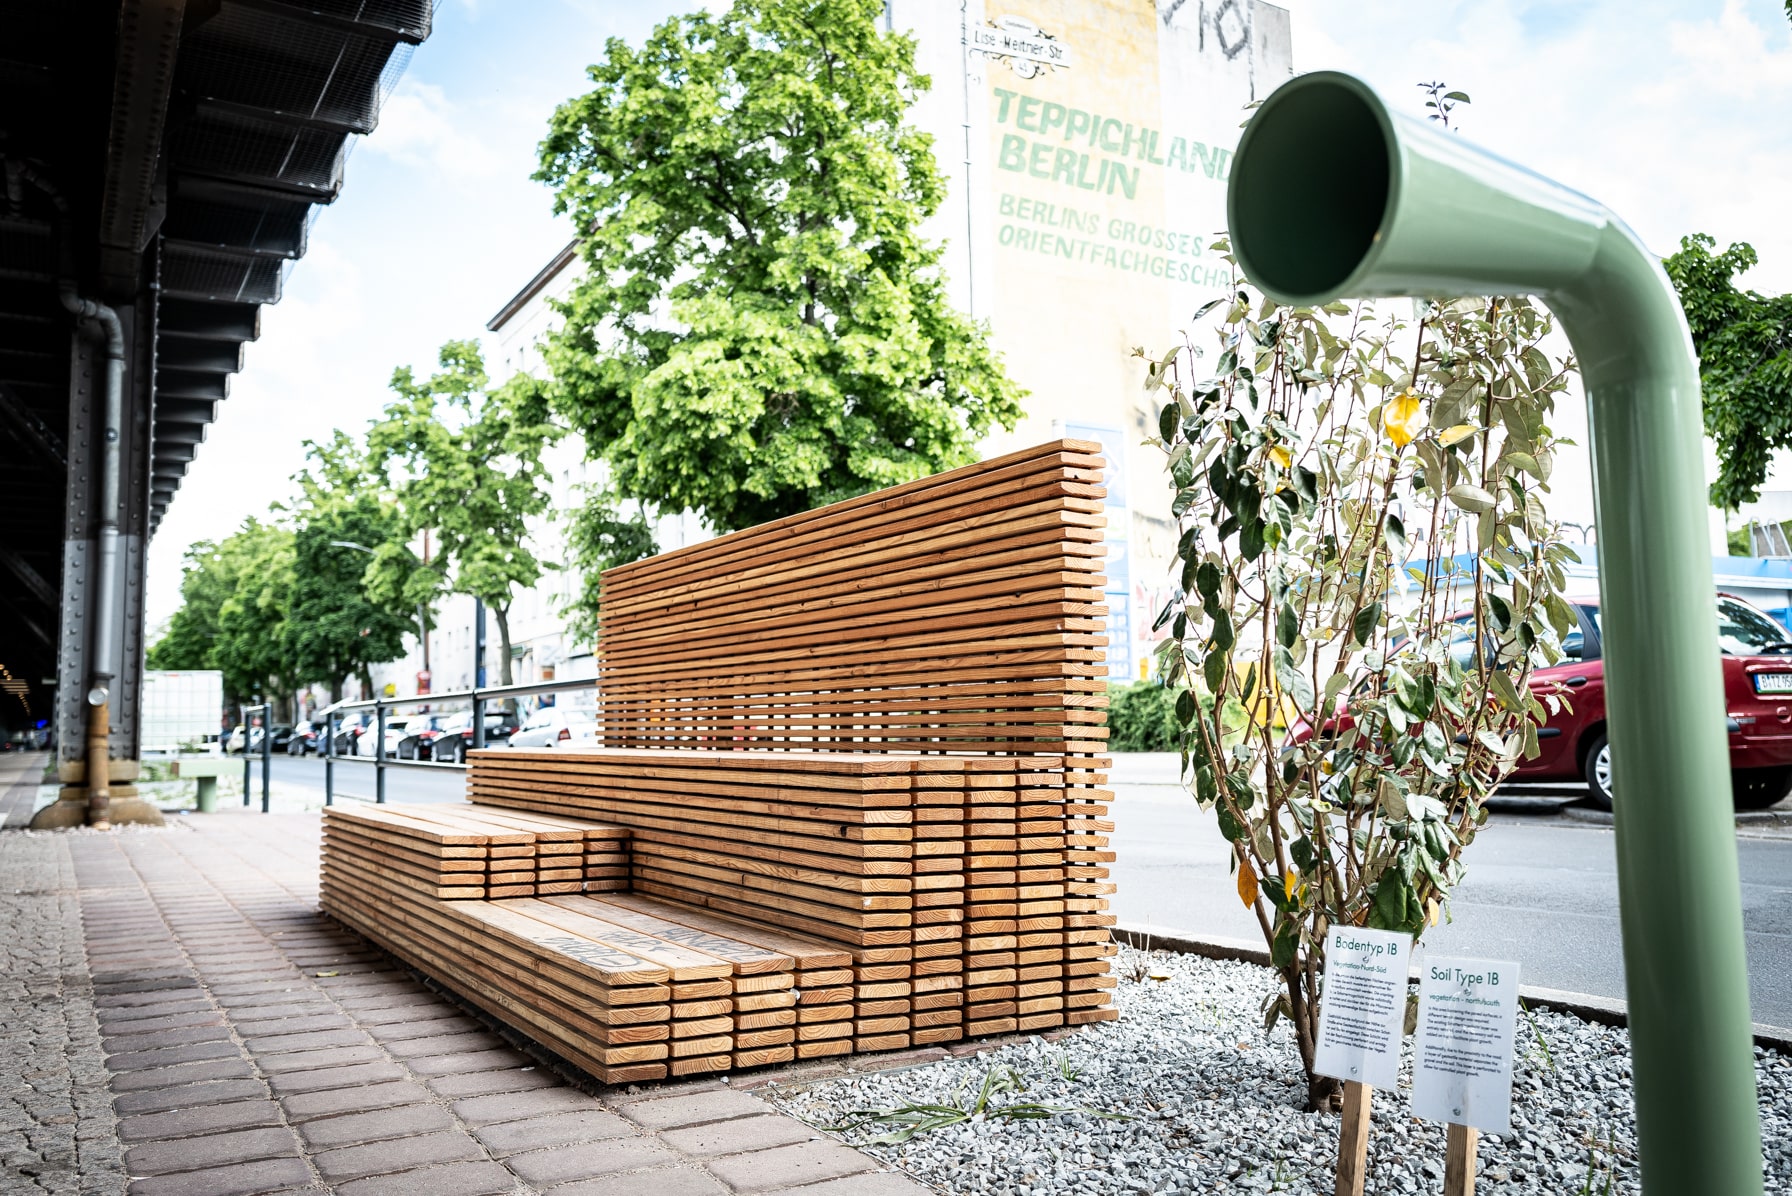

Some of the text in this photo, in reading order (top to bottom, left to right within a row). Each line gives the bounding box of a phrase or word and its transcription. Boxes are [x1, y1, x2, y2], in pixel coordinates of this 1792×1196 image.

[993, 87, 1236, 183] TEPPICHLAND
[998, 133, 1141, 200] BERLIN
[998, 224, 1241, 291] ORIENTFACHGESCHA
[999, 193, 1204, 258] BERLINS GROSSES
[1335, 935, 1398, 957] Bodentyp 1B
[1430, 966, 1500, 987] Soil Type 1B
